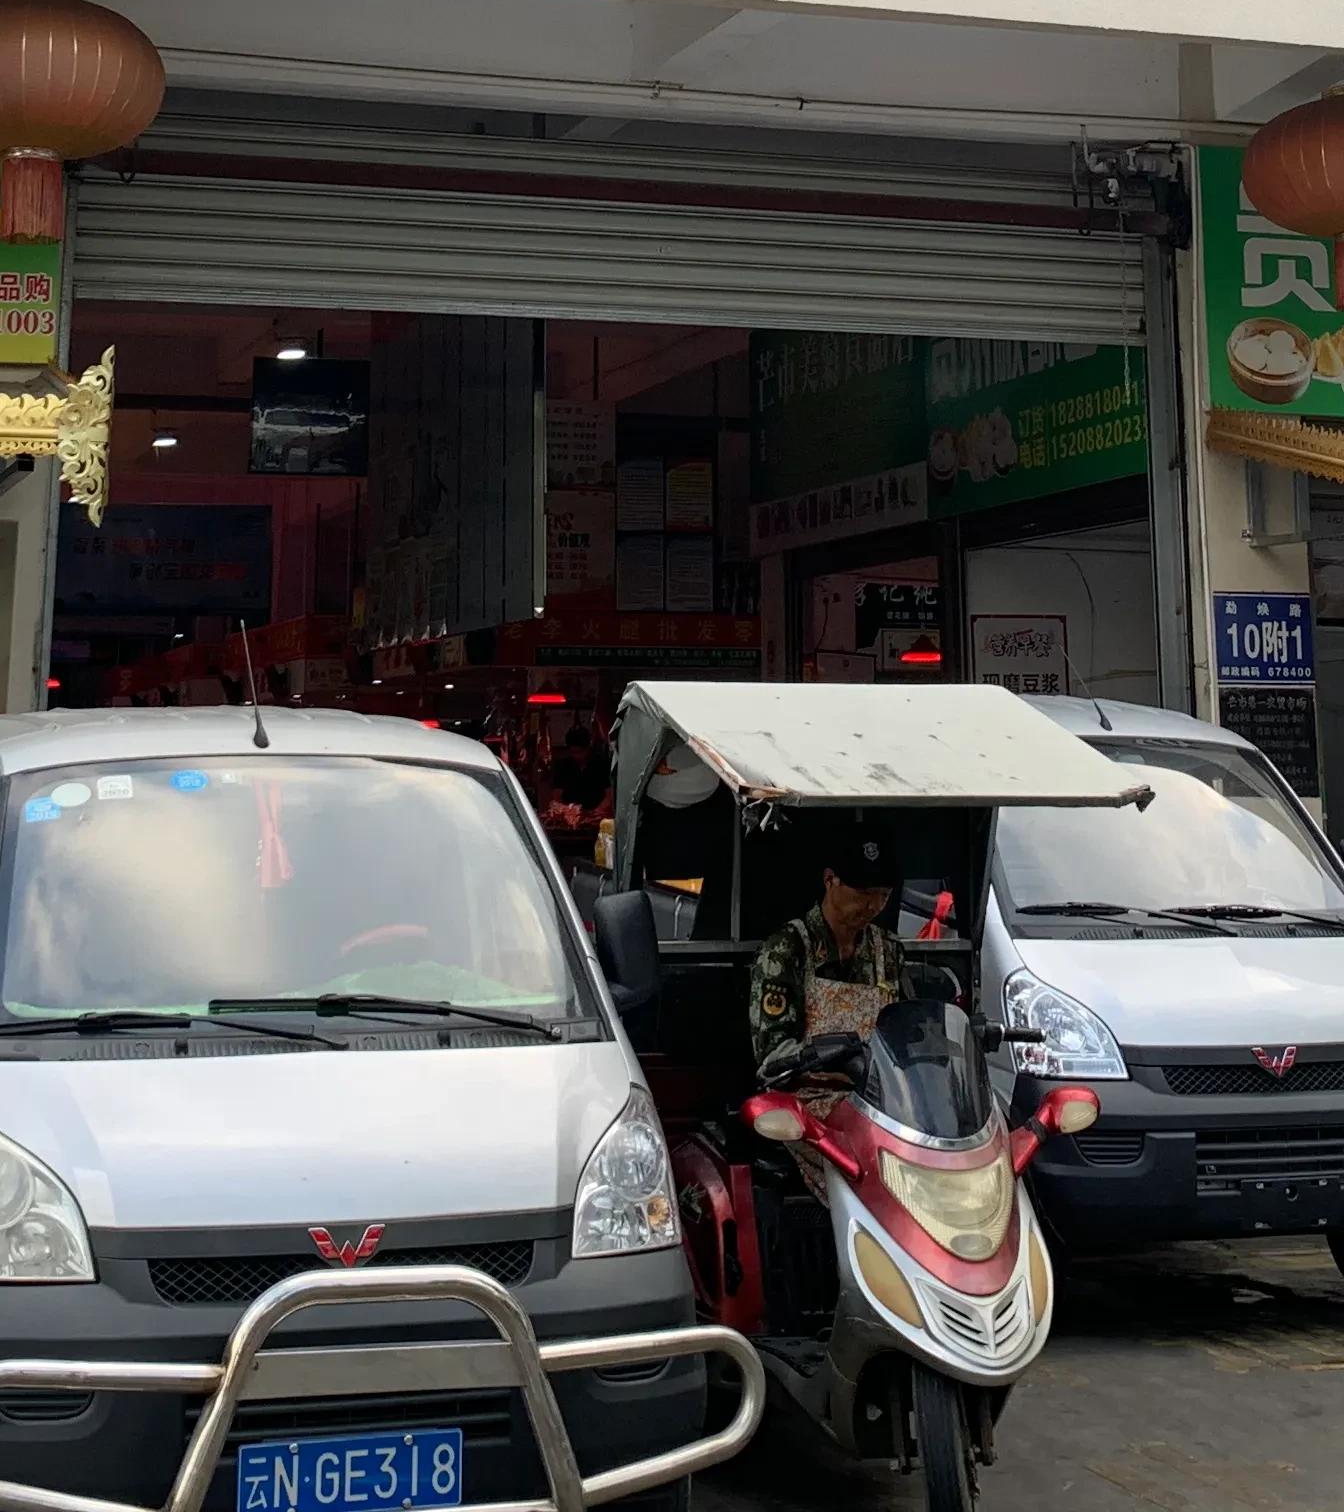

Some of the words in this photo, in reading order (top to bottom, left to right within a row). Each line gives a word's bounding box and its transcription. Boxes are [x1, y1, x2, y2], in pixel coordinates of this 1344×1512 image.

[1226, 620, 1304, 664] 10附1
[1221, 666, 1260, 677] 邮政编码
[1267, 666, 1312, 678] 678400
[244, 1442, 456, 1510] 云N·GE318
